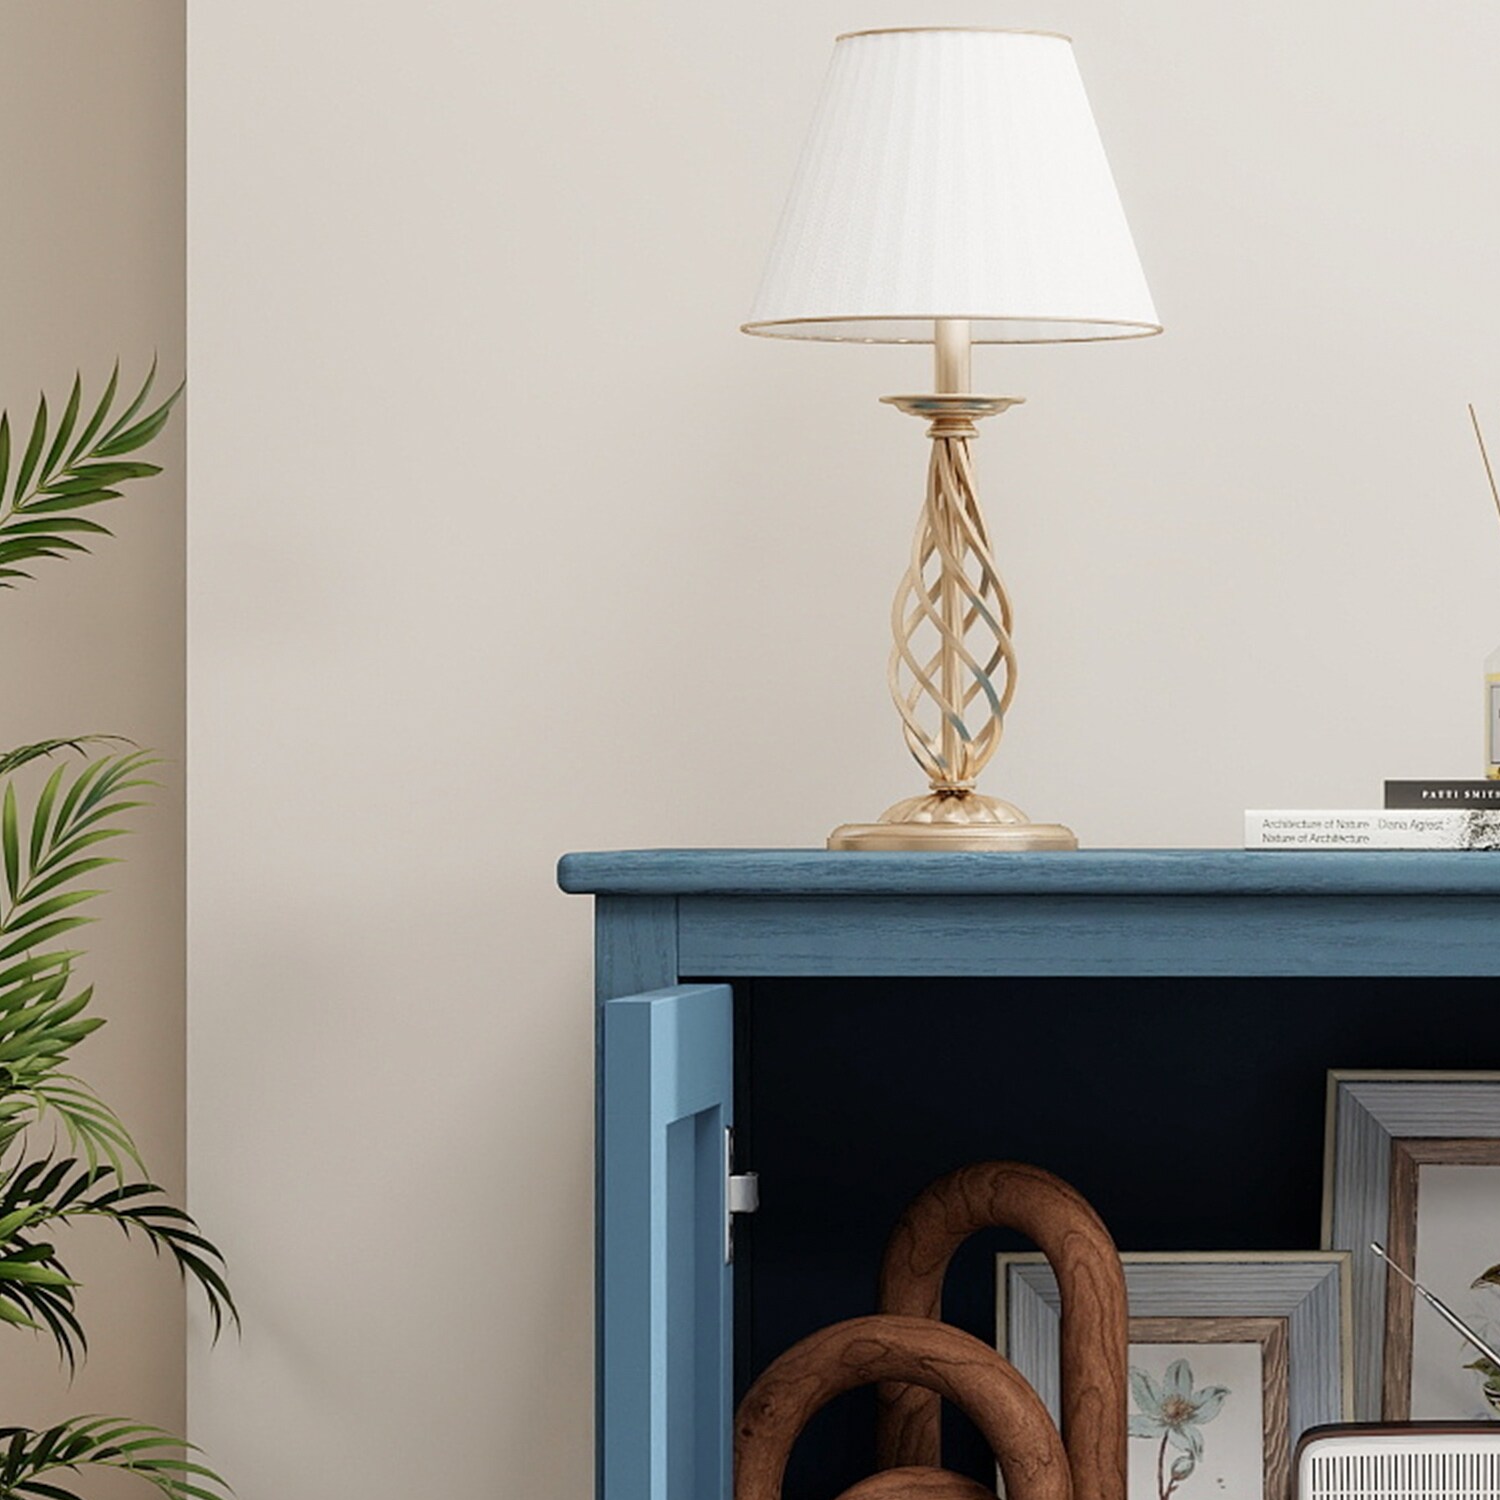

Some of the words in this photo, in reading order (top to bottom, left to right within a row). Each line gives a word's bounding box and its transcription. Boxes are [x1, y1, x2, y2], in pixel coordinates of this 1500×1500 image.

[1422, 790, 1458, 799] PATTI
[1262, 819, 1322, 829] Architecture
[1324, 819, 1334, 829] of
[1336, 819, 1370, 829] Nature
[1262, 833, 1295, 843] Nature
[1297, 833, 1307, 843] of
[1309, 833, 1370, 843] Architecture
